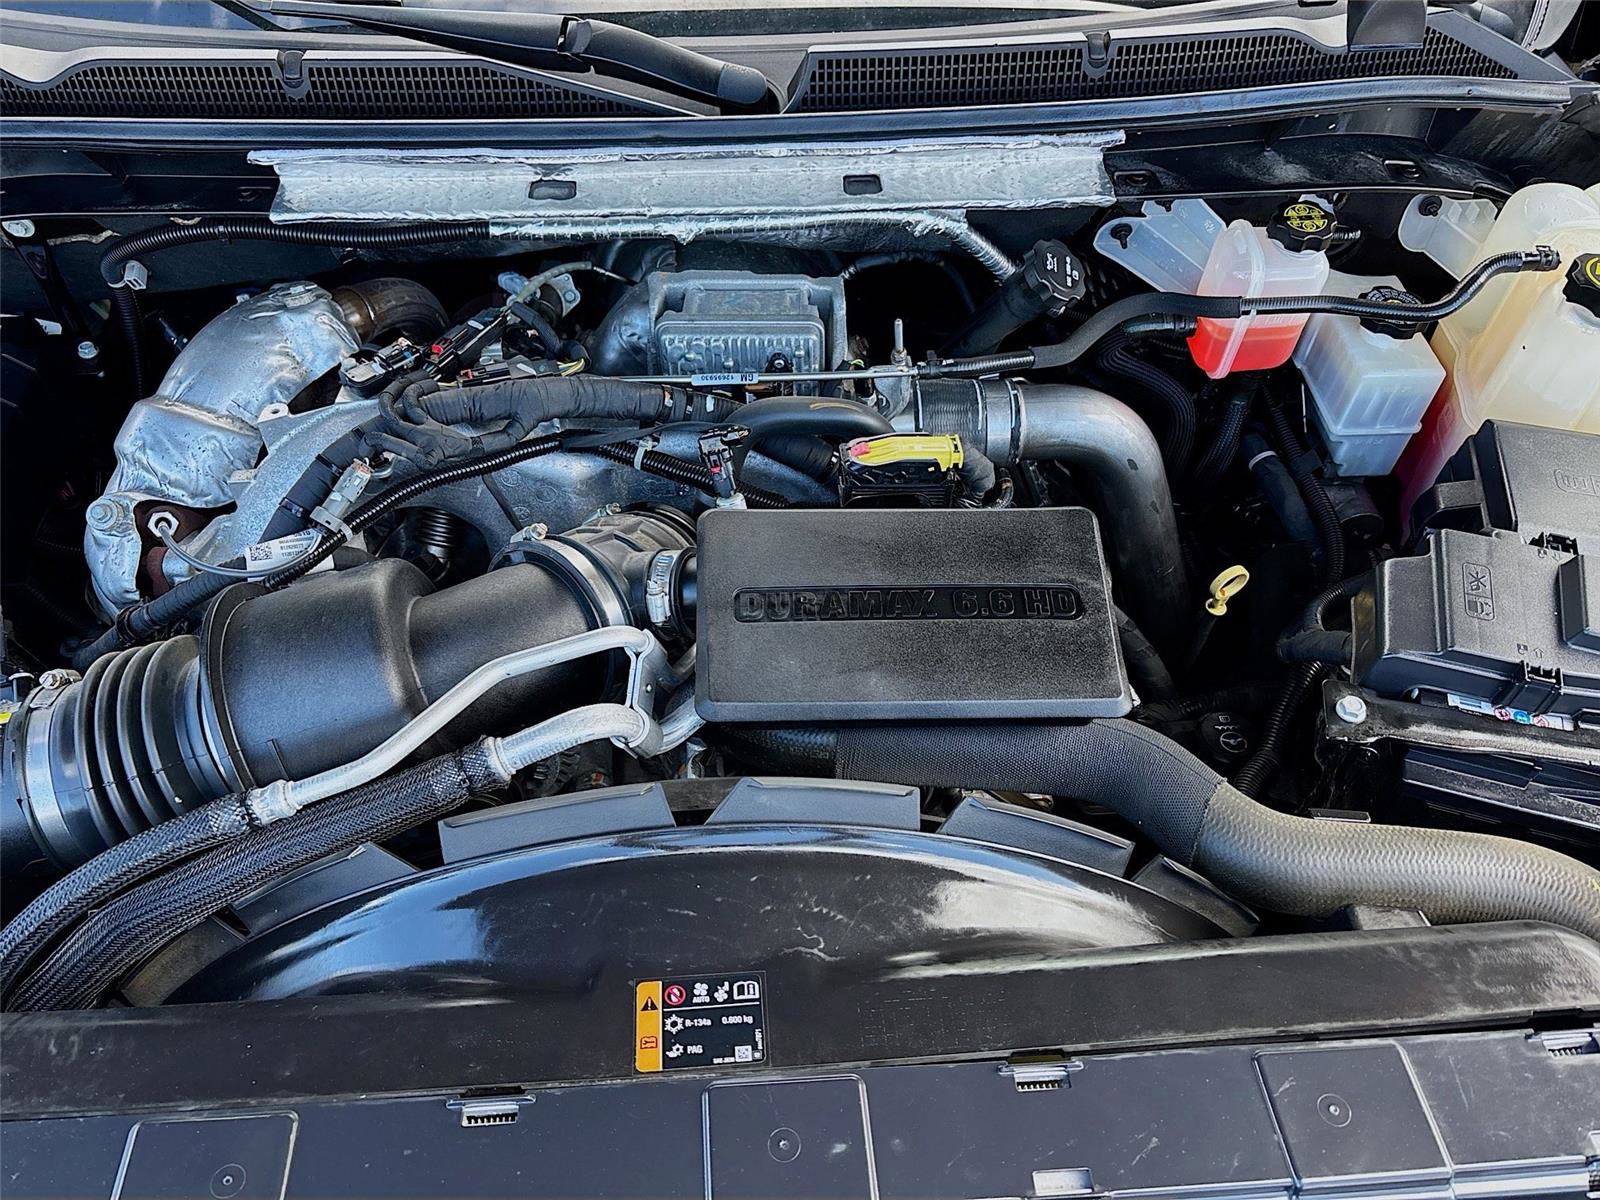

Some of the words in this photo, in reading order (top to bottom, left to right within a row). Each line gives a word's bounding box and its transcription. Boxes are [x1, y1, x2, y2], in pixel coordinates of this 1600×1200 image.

[740, 373, 754, 382] GM
[739, 590, 938, 620] DURAMAX
[952, 588, 1016, 617] 6.6
[1023, 588, 1078, 617] HD
[685, 1018, 711, 1027] R-134a
[743, 1015, 753, 1024] kg
[686, 1045, 703, 1054] PAG
